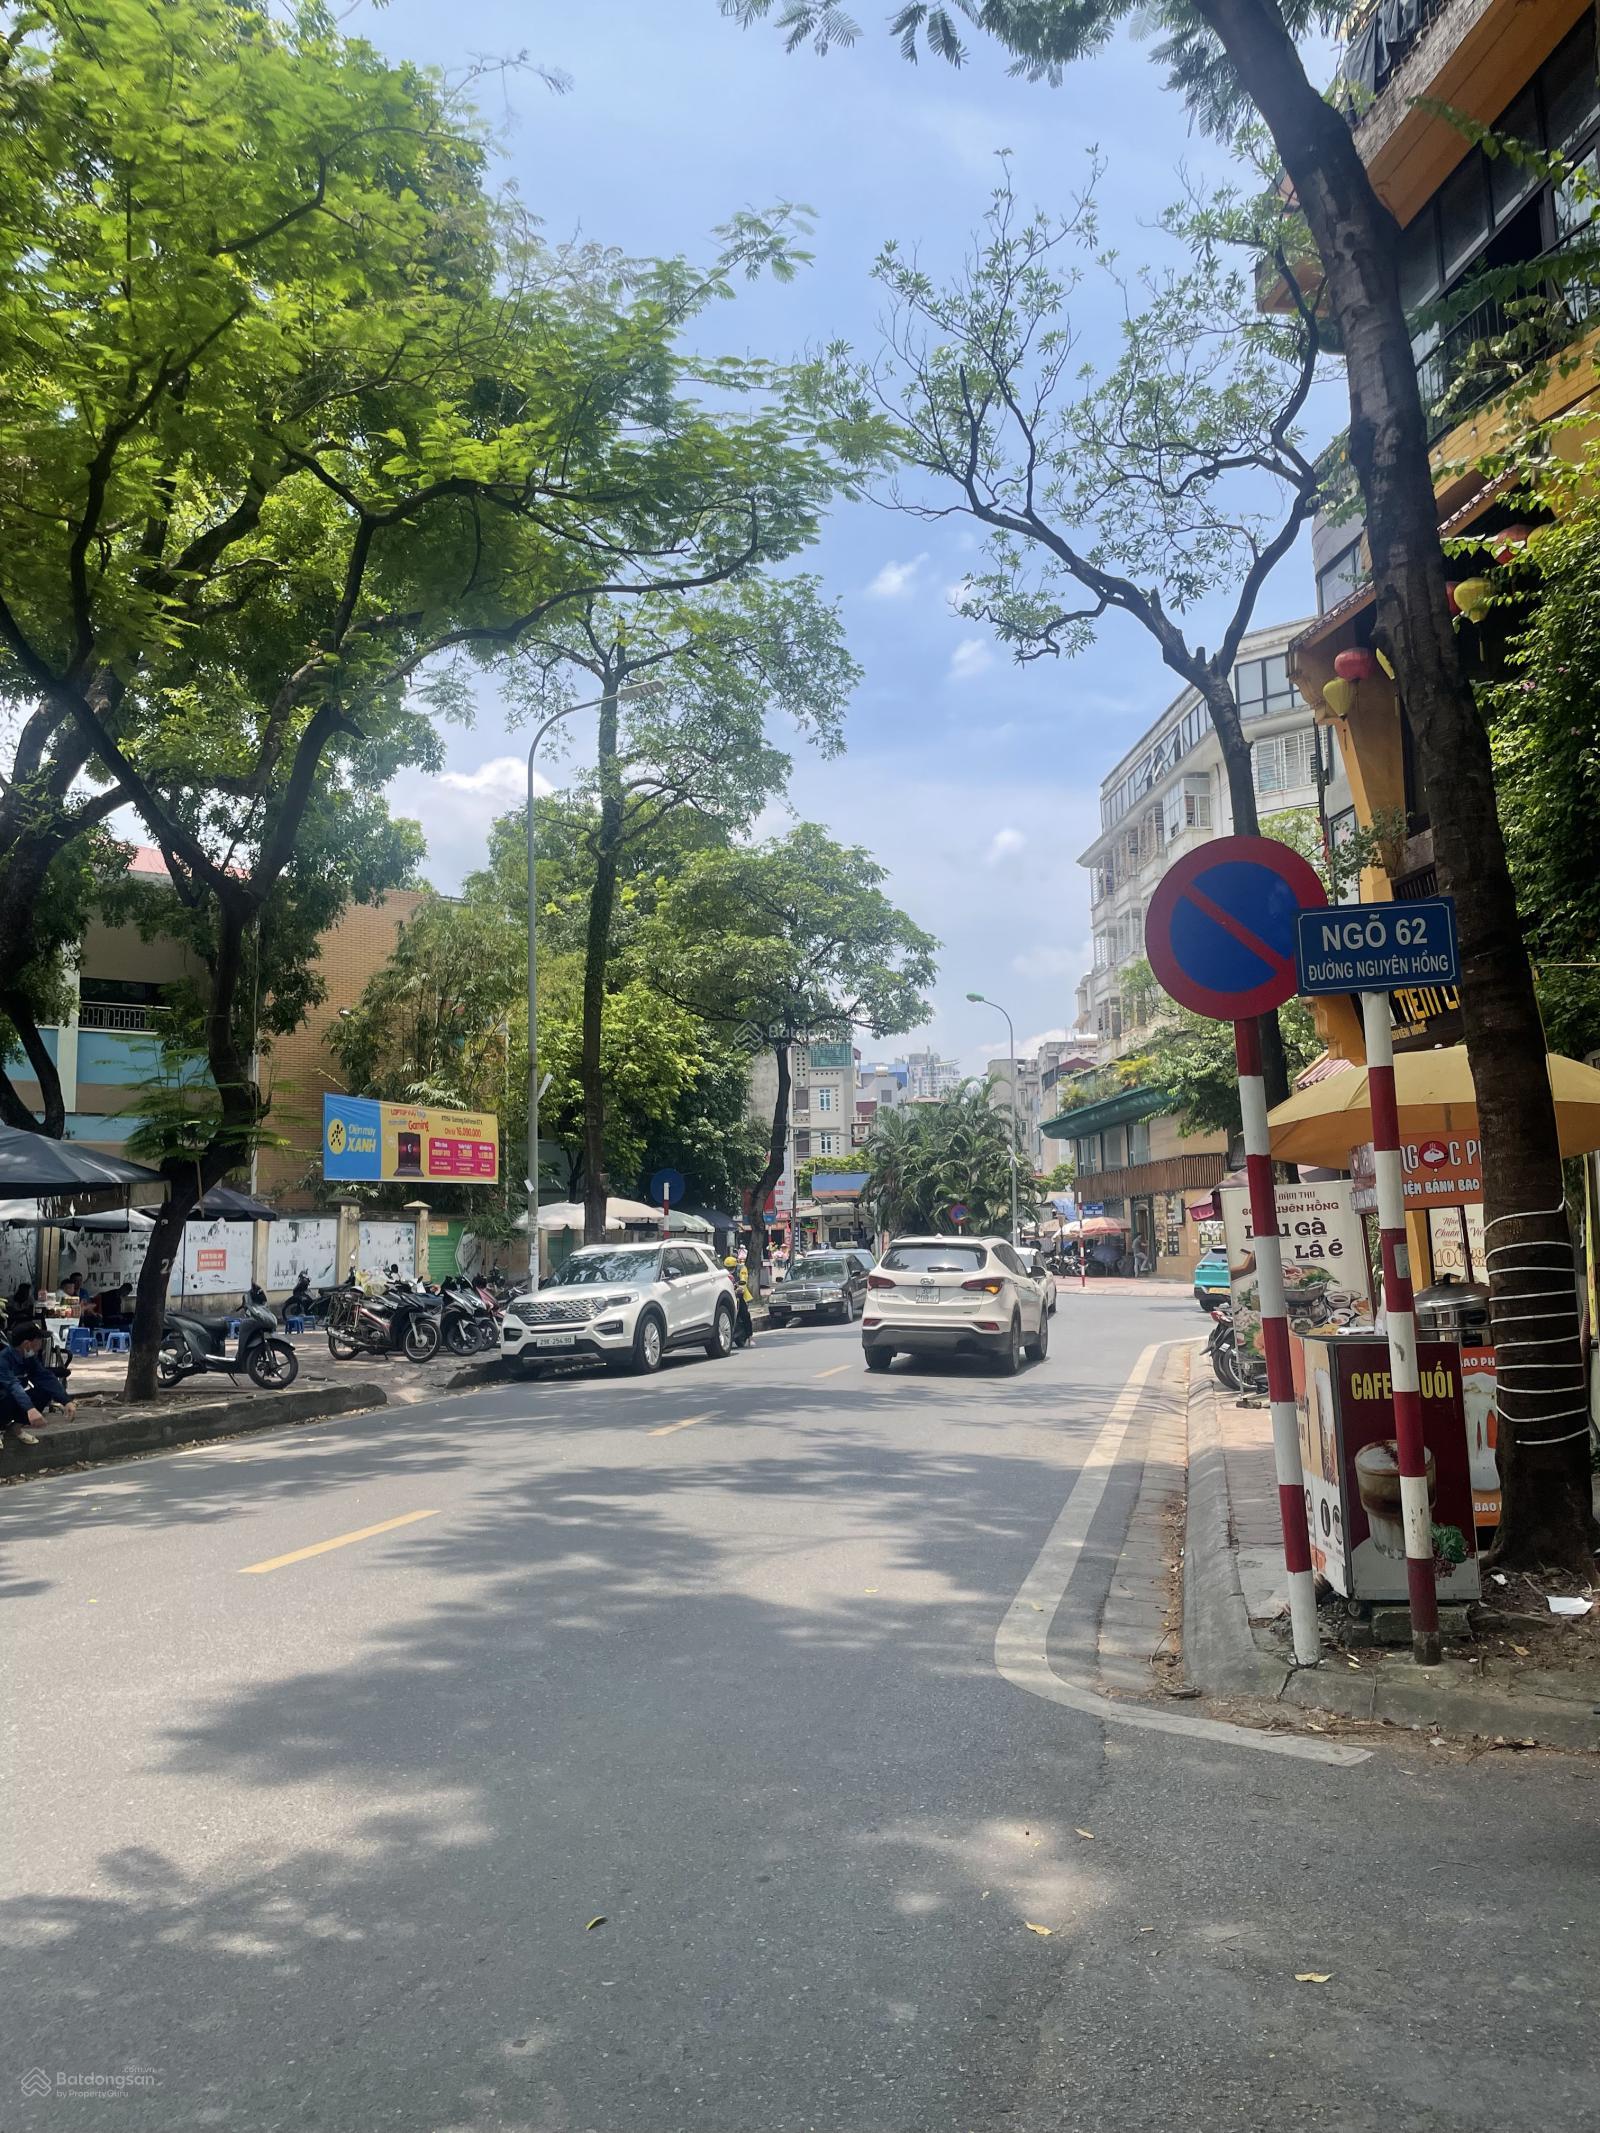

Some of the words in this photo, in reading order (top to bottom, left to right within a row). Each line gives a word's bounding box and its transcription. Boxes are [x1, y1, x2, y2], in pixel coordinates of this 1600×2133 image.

[1321, 914, 1387, 952] NGÕ
[1395, 917, 1428, 946] 62
[1308, 958, 1354, 982] ĐƯỜNG
[1356, 954, 1409, 978] NGUYÊN
[1412, 949, 1449, 973] HỒNG
[346, 1138, 377, 1153] XANH
[1403, 1180, 1422, 1198] IỆM
[1425, 1178, 1455, 1194] BÁNH
[1458, 1178, 1480, 1192] BAO
[1306, 1199, 1339, 1212] HỒNG
[1351, 1372, 1393, 1400] CAFE
[1420, 1360, 1454, 1399] UỐI
[1474, 1502, 1497, 1512] BAO
